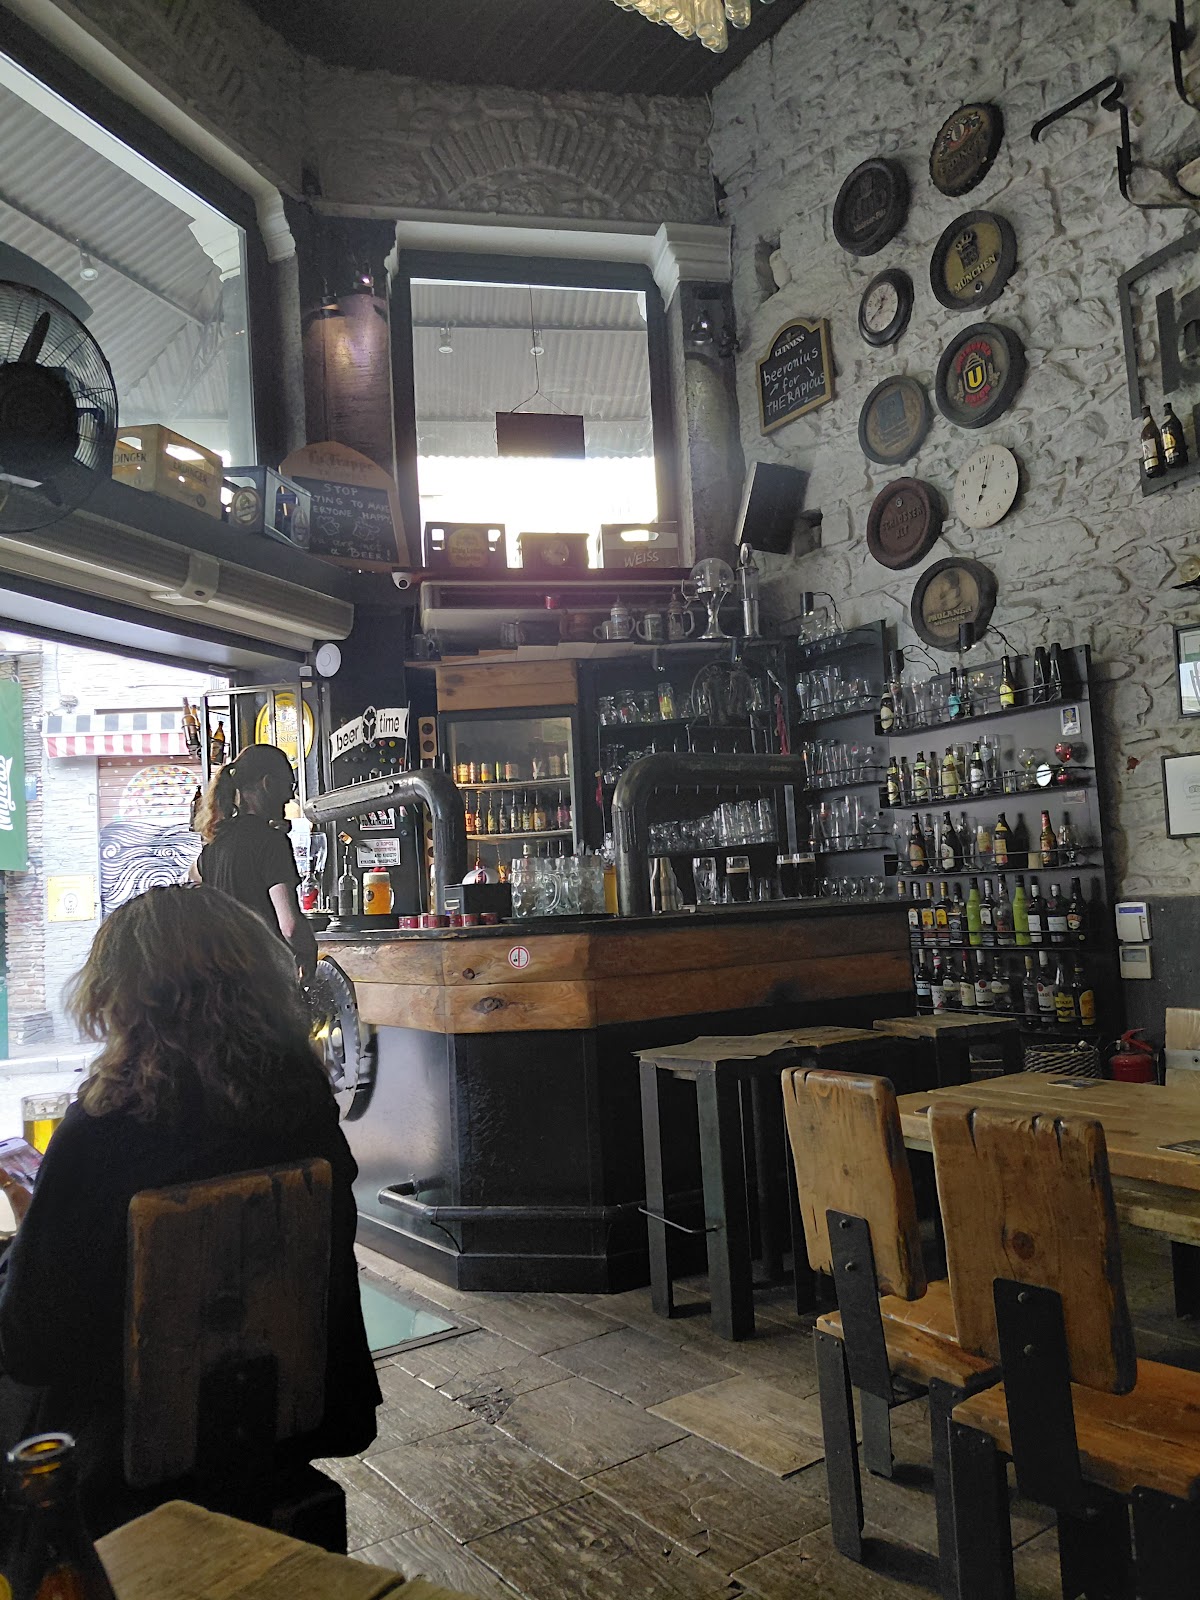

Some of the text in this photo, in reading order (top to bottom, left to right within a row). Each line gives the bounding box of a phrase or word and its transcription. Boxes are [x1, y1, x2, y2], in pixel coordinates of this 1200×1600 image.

[954, 253, 997, 294] MÜNCHEN
[774, 334, 806, 358] GUINNESS
[763, 347, 819, 387] beeronius
[967, 365, 983, 388] U
[782, 374, 801, 393] for
[765, 372, 826, 416] THERAPIOUS
[114, 452, 148, 464] DINGER
[978, 455, 986, 464] 12
[172, 461, 209, 485] ERDINGER
[323, 483, 359, 496] STOP
[312, 505, 353, 518] ERYONE
[350, 499, 364, 509] TO
[368, 502, 391, 513] MAKE
[332, 539, 354, 548] are
[623, 551, 660, 568] WEISS
[927, 605, 973, 623] PAULANER
[379, 712, 400, 733] time
[336, 724, 360, 752] beer
